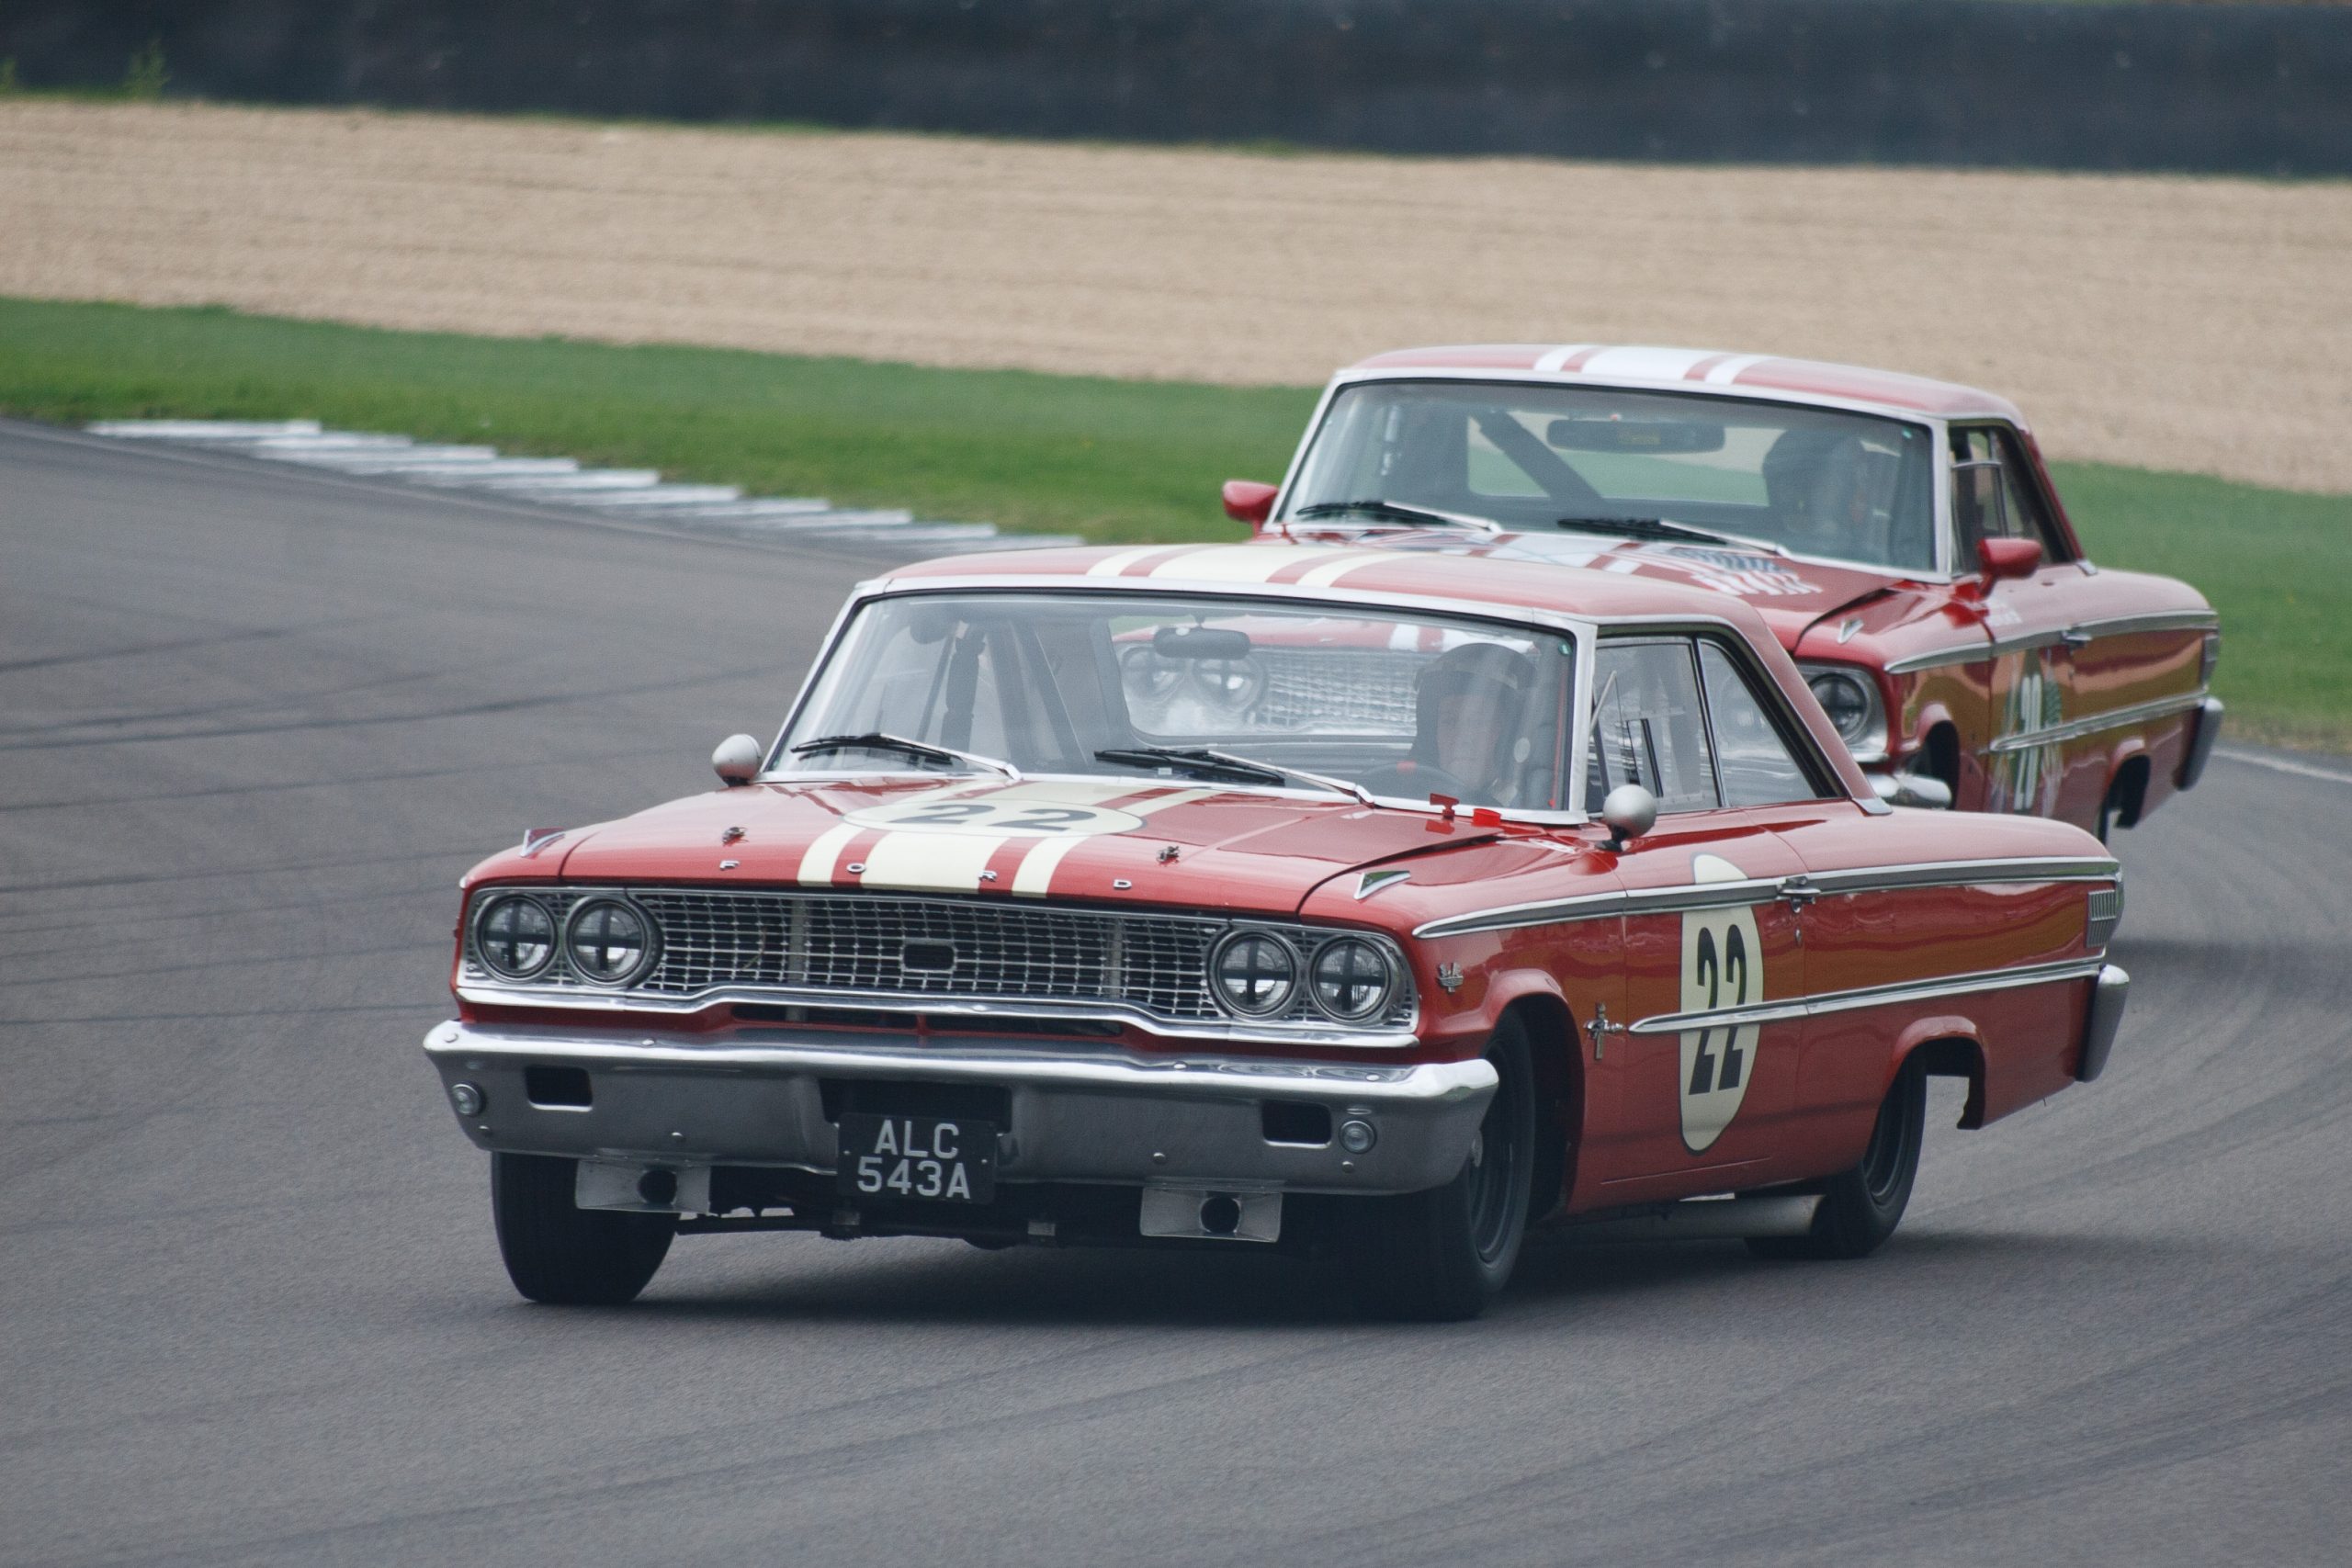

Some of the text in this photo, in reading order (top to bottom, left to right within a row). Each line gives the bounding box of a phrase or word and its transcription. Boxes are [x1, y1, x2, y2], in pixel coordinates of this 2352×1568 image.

[887, 804, 1097, 832] 22
[1689, 923, 1747, 1096] 22
[874, 1119, 960, 1159] ALC
[857, 1156, 971, 1200] 543A
